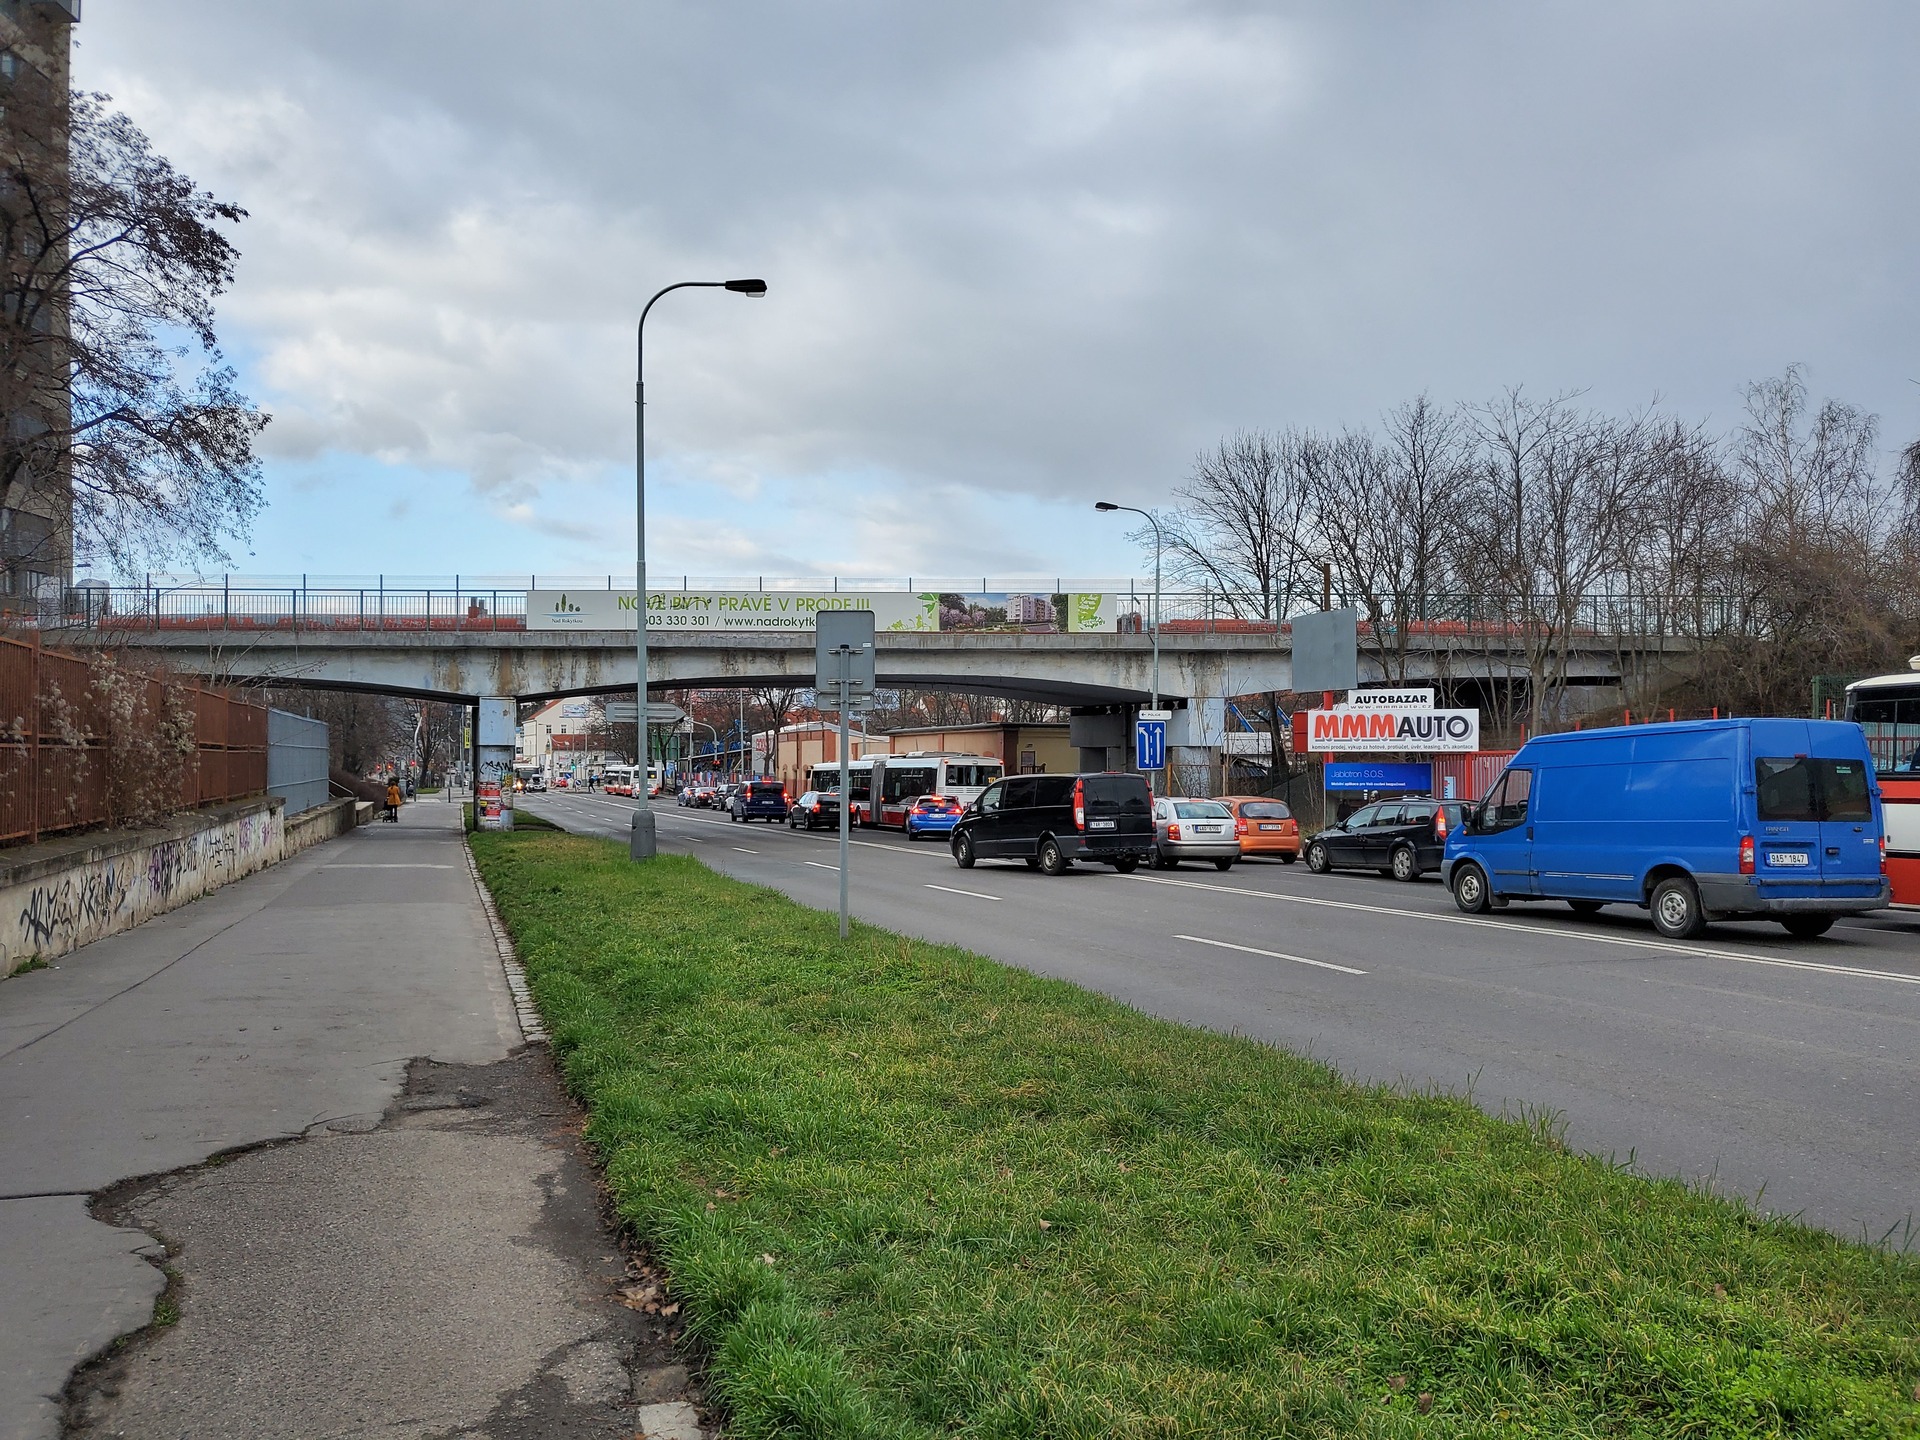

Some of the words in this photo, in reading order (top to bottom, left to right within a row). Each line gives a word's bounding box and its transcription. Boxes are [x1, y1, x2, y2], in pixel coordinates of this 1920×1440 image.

[718, 593, 772, 611] PRÁVĚ
[778, 597, 790, 611] V
[666, 616, 687, 626] 330
[691, 616, 709, 626] 301
[724, 616, 816, 629] www.nadrokytk
[1355, 695, 1428, 704] AUTOBAZAR
[1314, 714, 1472, 740] MMMAUTO
[1331, 770, 1362, 778] Jablotron
[1771, 854, 1785, 863] 9A5
[1789, 855, 1805, 863] 1847
